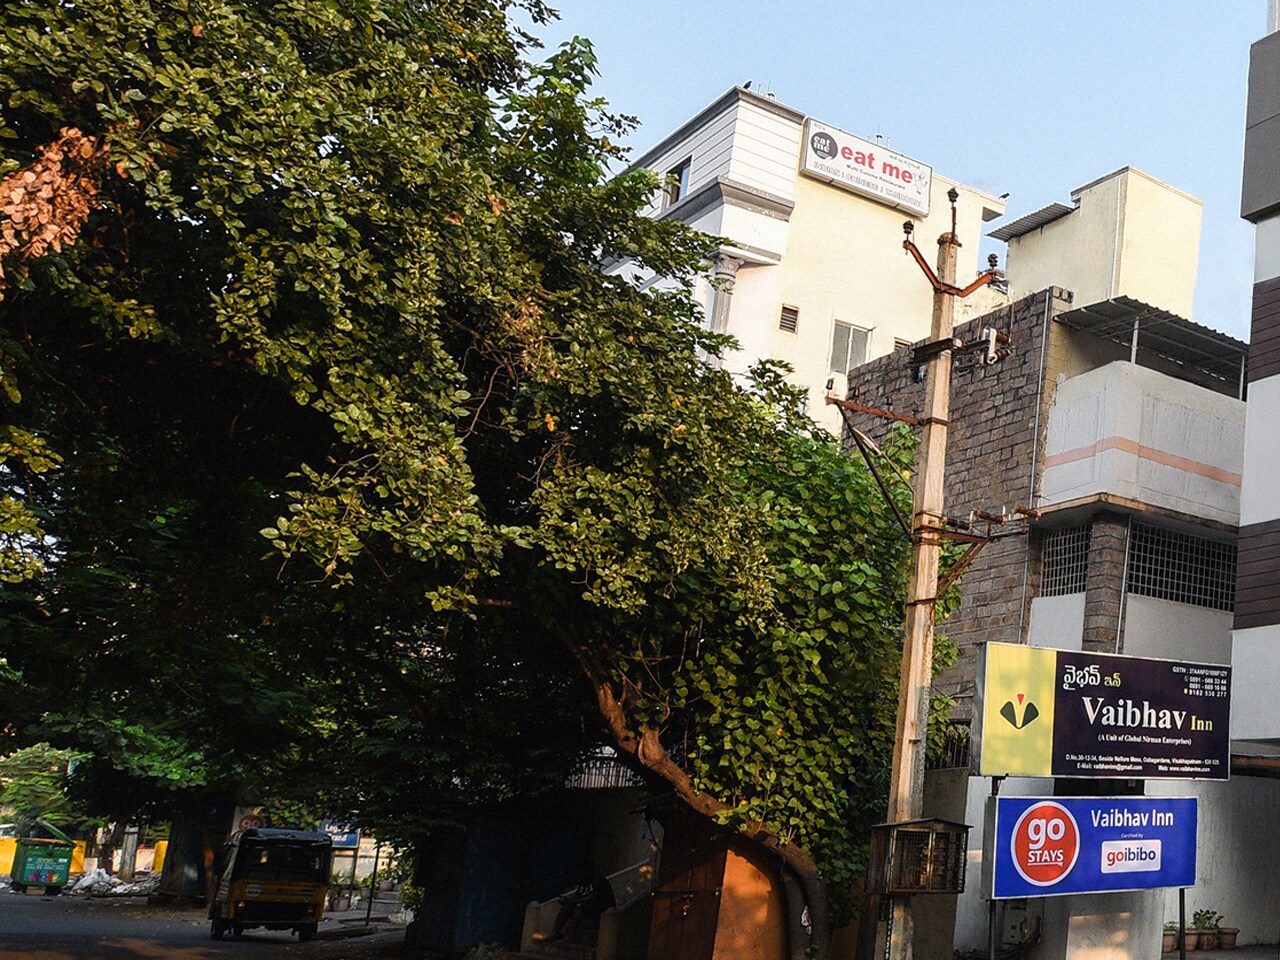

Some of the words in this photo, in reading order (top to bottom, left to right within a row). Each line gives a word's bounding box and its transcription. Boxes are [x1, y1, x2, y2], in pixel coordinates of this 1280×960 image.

[841, 146, 875, 169] eat
[882, 161, 913, 184] me
[1082, 697, 1187, 730] Vaibhav
[1191, 716, 1213, 731] Inn
[1106, 734, 1118, 742] Unit
[1091, 808, 1149, 827] Vaibhav
[1152, 809, 1174, 826] Inn
[1028, 818, 1065, 849] go
[1028, 850, 1064, 862] STAYS
[1107, 846, 1156, 866] goibibo
